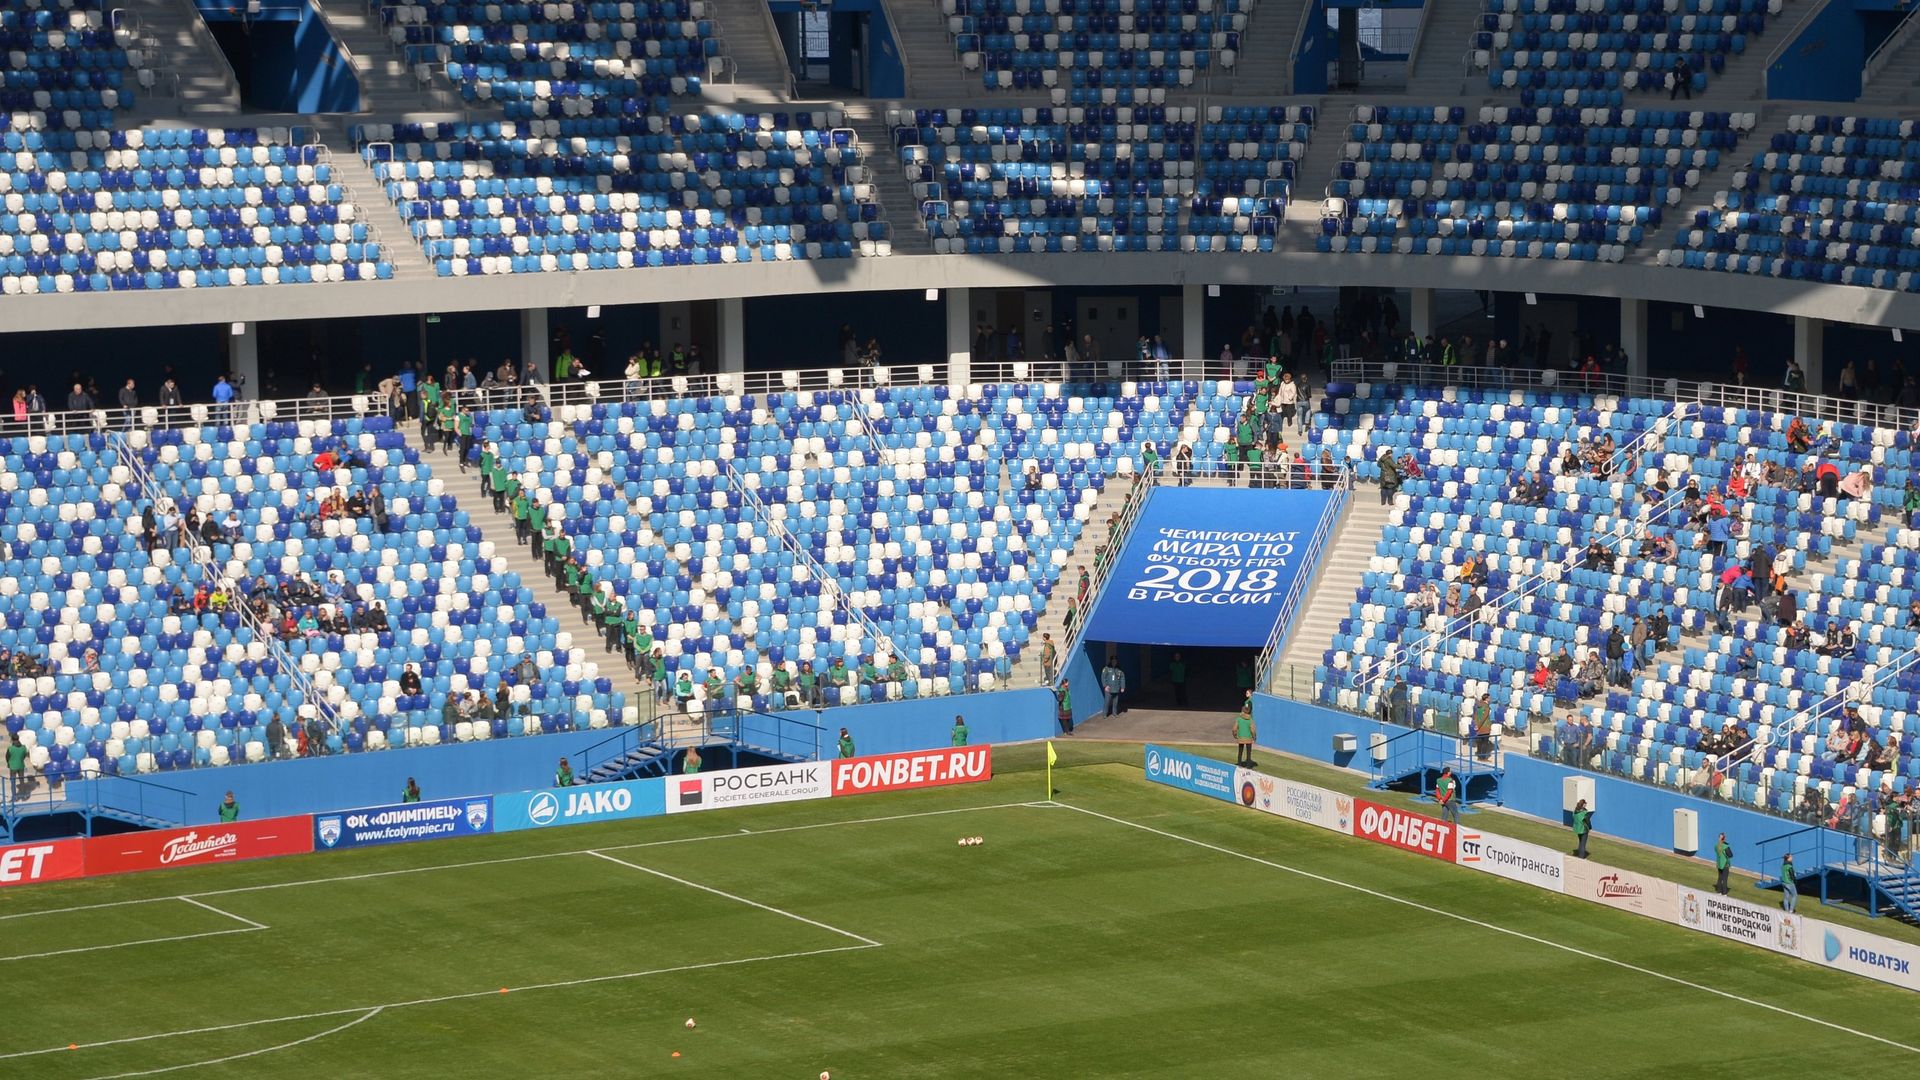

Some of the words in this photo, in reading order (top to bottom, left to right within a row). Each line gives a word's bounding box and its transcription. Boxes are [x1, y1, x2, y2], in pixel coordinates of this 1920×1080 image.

[1159, 528, 1300, 542] ЧЕМПИОНАТ
[1153, 540, 1241, 557] МИРА
[1250, 543, 1294, 557] ПО
[1147, 554, 1242, 567] ФУТБОЛУ
[1245, 557, 1287, 568] FIFA
[1135, 565, 1279, 592] 2018
[1127, 588, 1148, 600] В
[713, 767, 818, 792] РОСБАНК
[836, 750, 986, 791] FONBET.RU
[1163, 757, 1192, 780] JAKO
[564, 788, 632, 817] JAKO
[748, 789, 790, 800] GENERALE
[791, 786, 819, 795] GROUP
[346, 814, 369, 828] ФК
[370, 805, 463, 825] «ОЛИМПИЕЦ»
[355, 822, 455, 841] www.fcolympiec.ru
[1360, 806, 1450, 854] ФОНБЕТ
[1486, 845, 1560, 878] Стройтрансгаз
[1706, 909, 1772, 933] НИЖЕГОРОДСКОЙ
[1707, 899, 1770, 923] ПРАВИТЕЛЬСТВО
[1722, 922, 1757, 940] ОБЛАСТИ
[1849, 946, 1910, 974] НОВАТЭК
